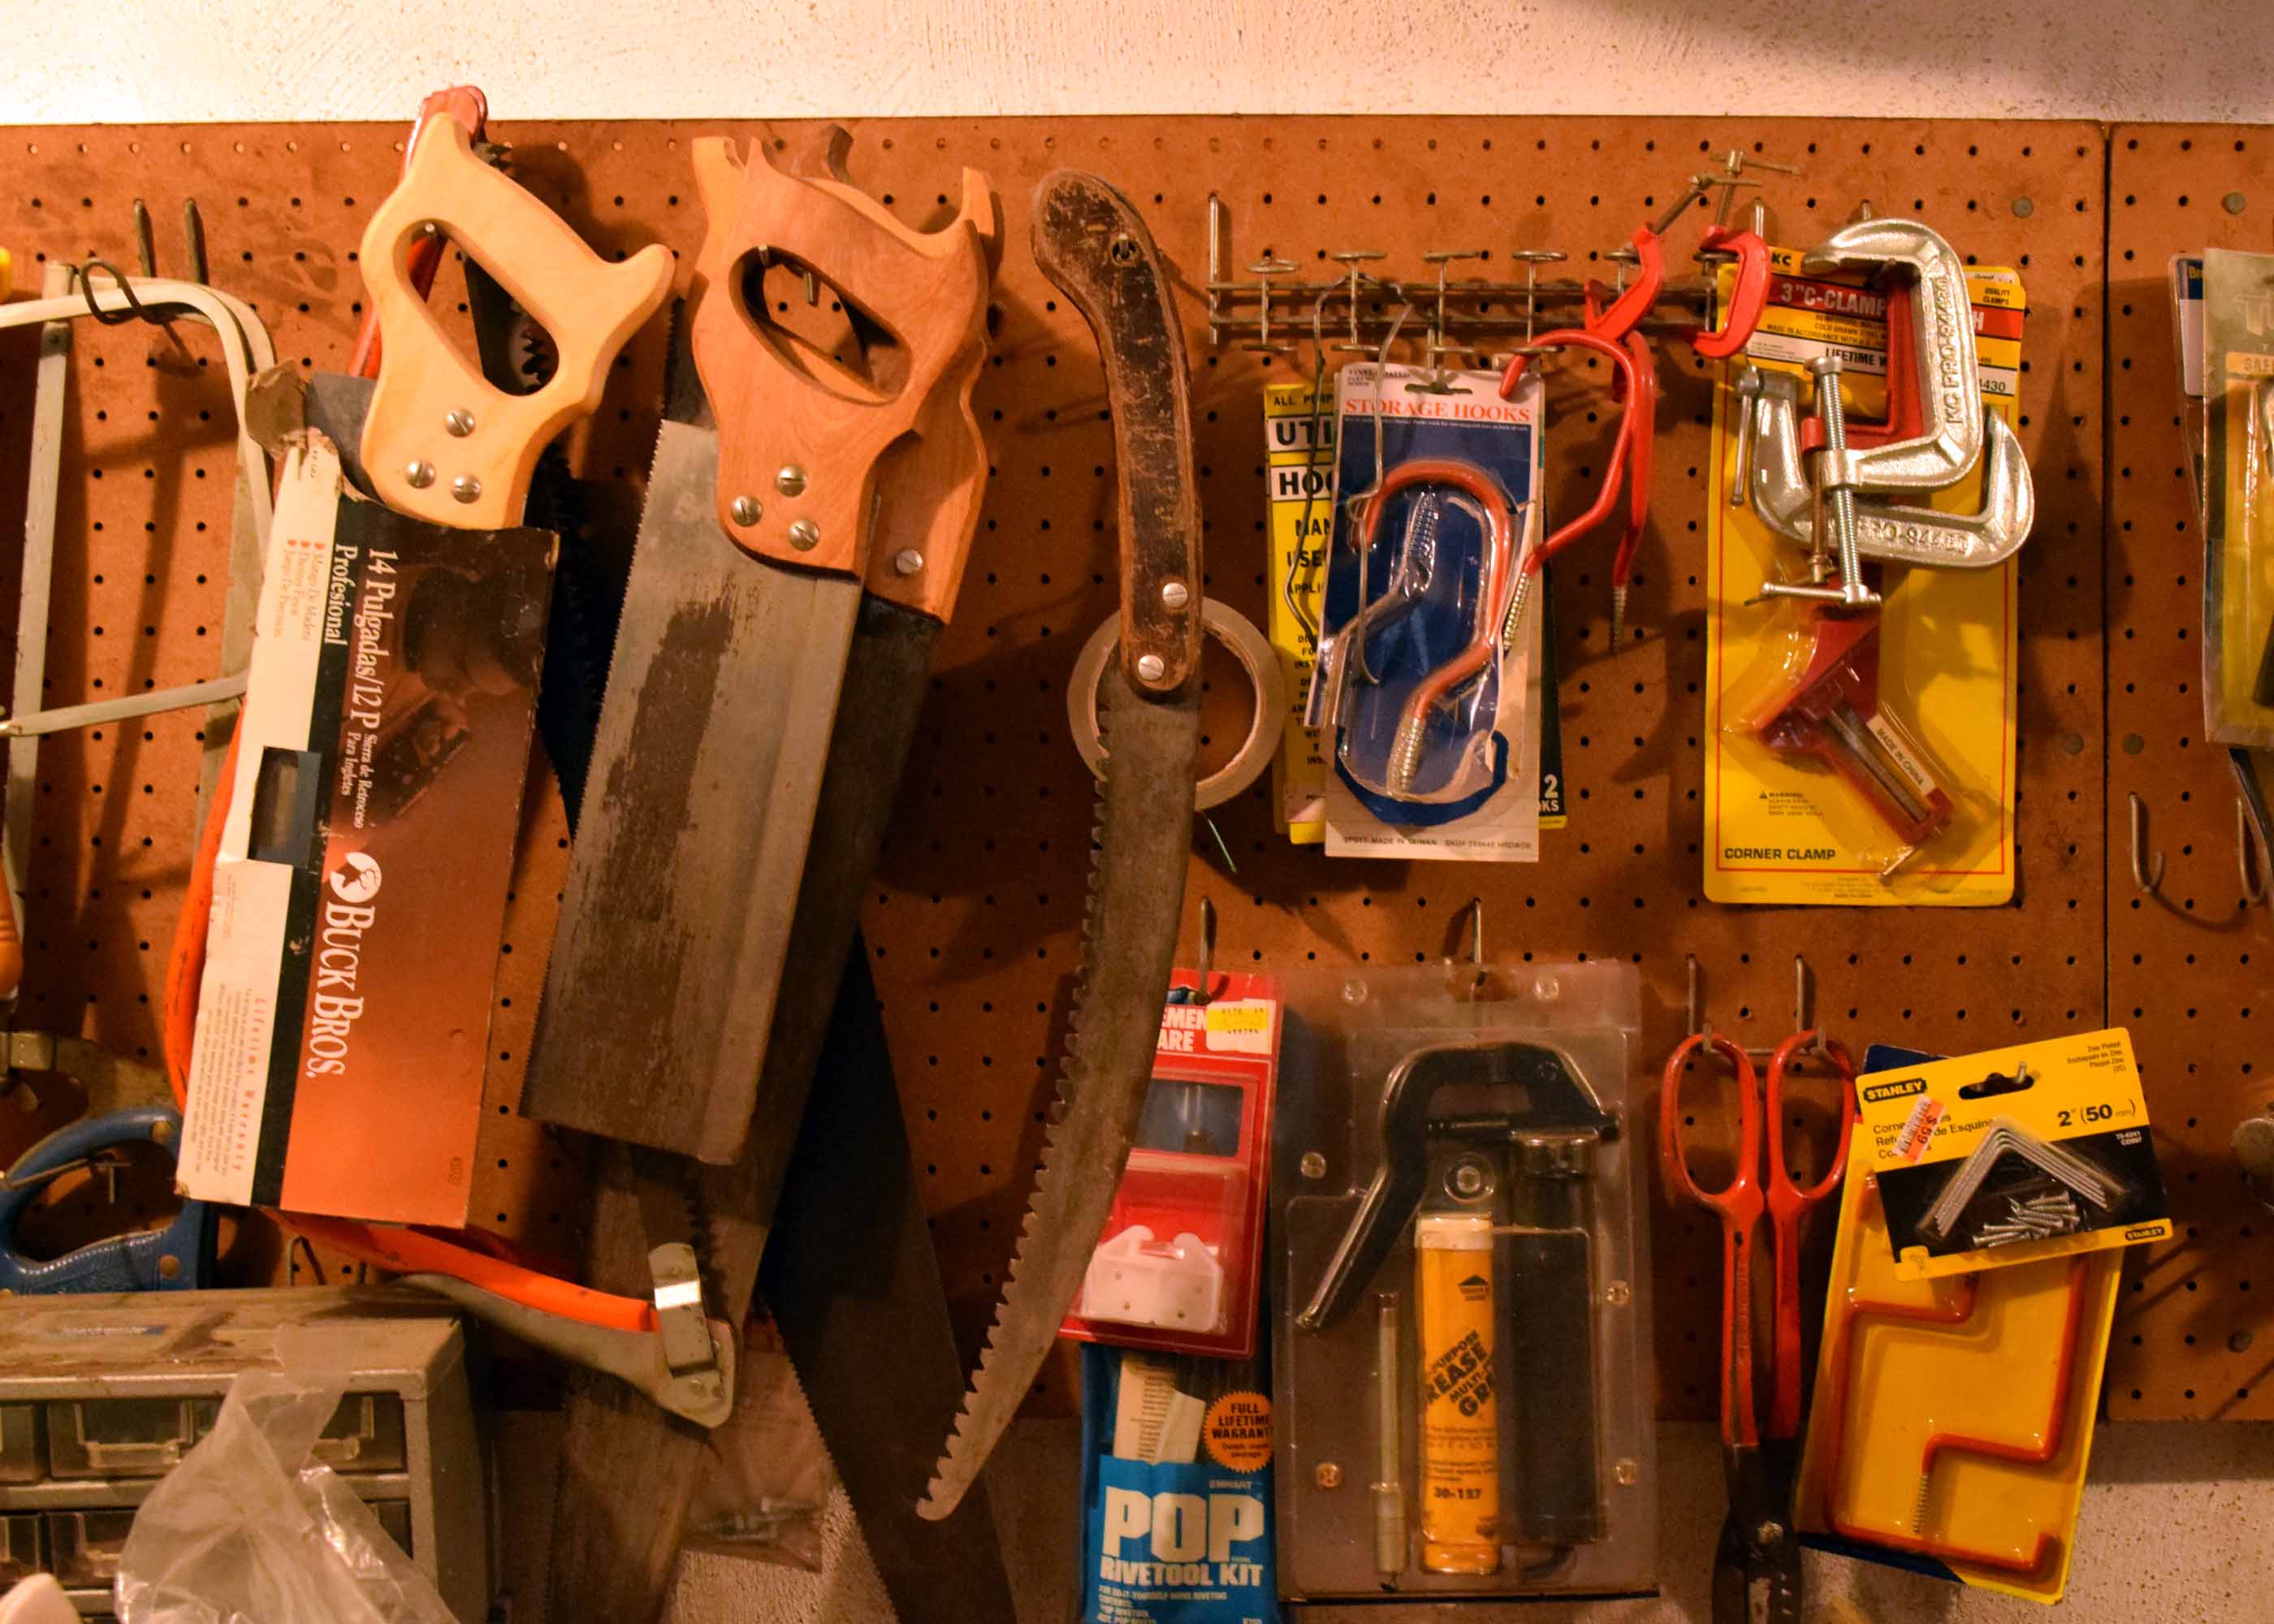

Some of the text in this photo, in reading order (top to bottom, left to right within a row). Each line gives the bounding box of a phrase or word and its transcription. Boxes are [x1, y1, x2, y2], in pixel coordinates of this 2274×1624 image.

[1273, 395, 1295, 406] ALL
[1345, 398, 1531, 421] STORAGE HOOKS
[1279, 470, 1332, 495] HO
[367, 548, 399, 575] 14
[324, 544, 358, 646] Profesional
[350, 579, 396, 709] Pulgadas/12
[362, 734, 378, 762] Sierra
[360, 764, 374, 778] de
[1544, 774, 1559, 798] 2
[1724, 847, 1835, 861] CORNER CLAMP
[305, 901, 376, 1079] BUCK BROS.
[1865, 1081, 1923, 1100] STANLEY
[1873, 1121, 1905, 1135] Corne
[1950, 1119, 1992, 1135] Esquin
[1230, 1403, 1259, 1414] FULL
[1212, 1427, 1273, 1440] WARRANT
[1103, 1486, 1265, 1563] POP
[1100, 1556, 1264, 1587] RIVETOOL KIT
